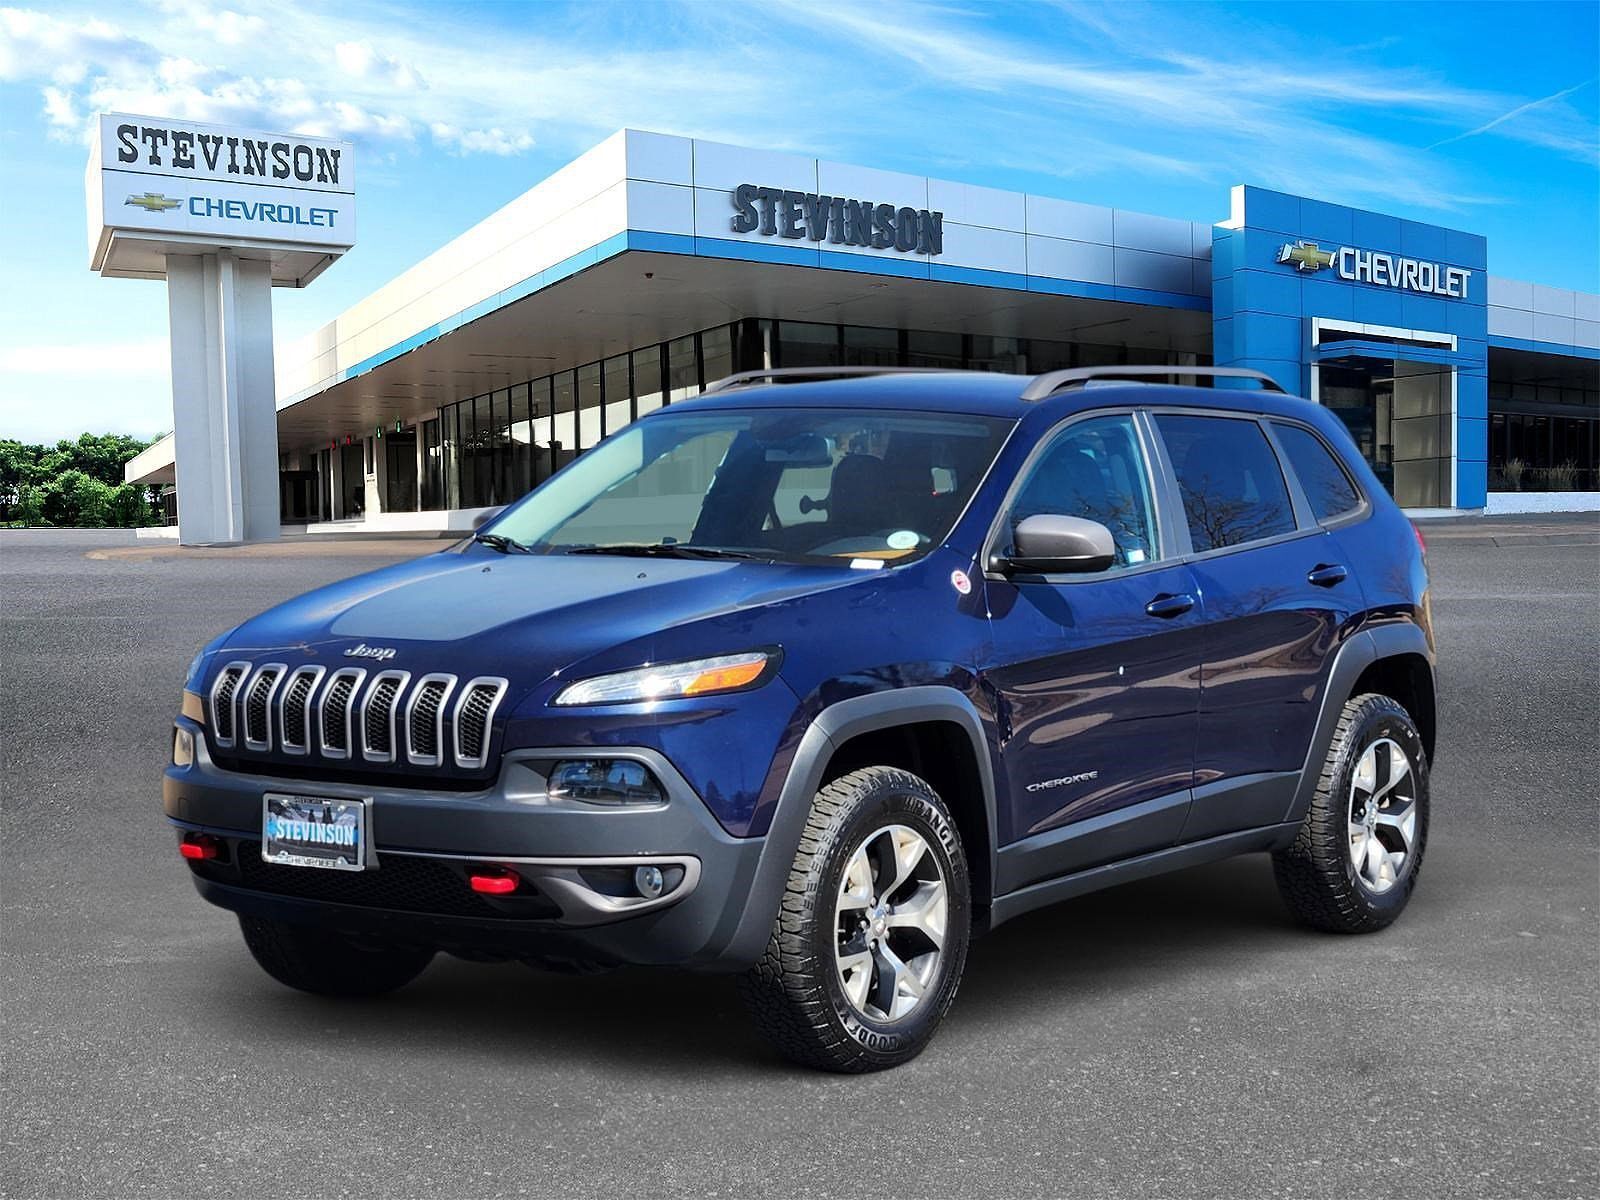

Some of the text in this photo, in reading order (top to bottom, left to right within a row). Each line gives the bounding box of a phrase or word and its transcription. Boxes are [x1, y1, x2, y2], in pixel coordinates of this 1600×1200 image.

[117, 124, 341, 185] STEVINSON
[189, 196, 338, 228] CHEVROLET
[731, 183, 944, 255] STEVINSON
[1337, 246, 1472, 298] CHEVROLET
[343, 643, 397, 662] Jeep
[1025, 770, 1099, 792] CHEROKEE
[275, 819, 356, 846] STEVINSON
